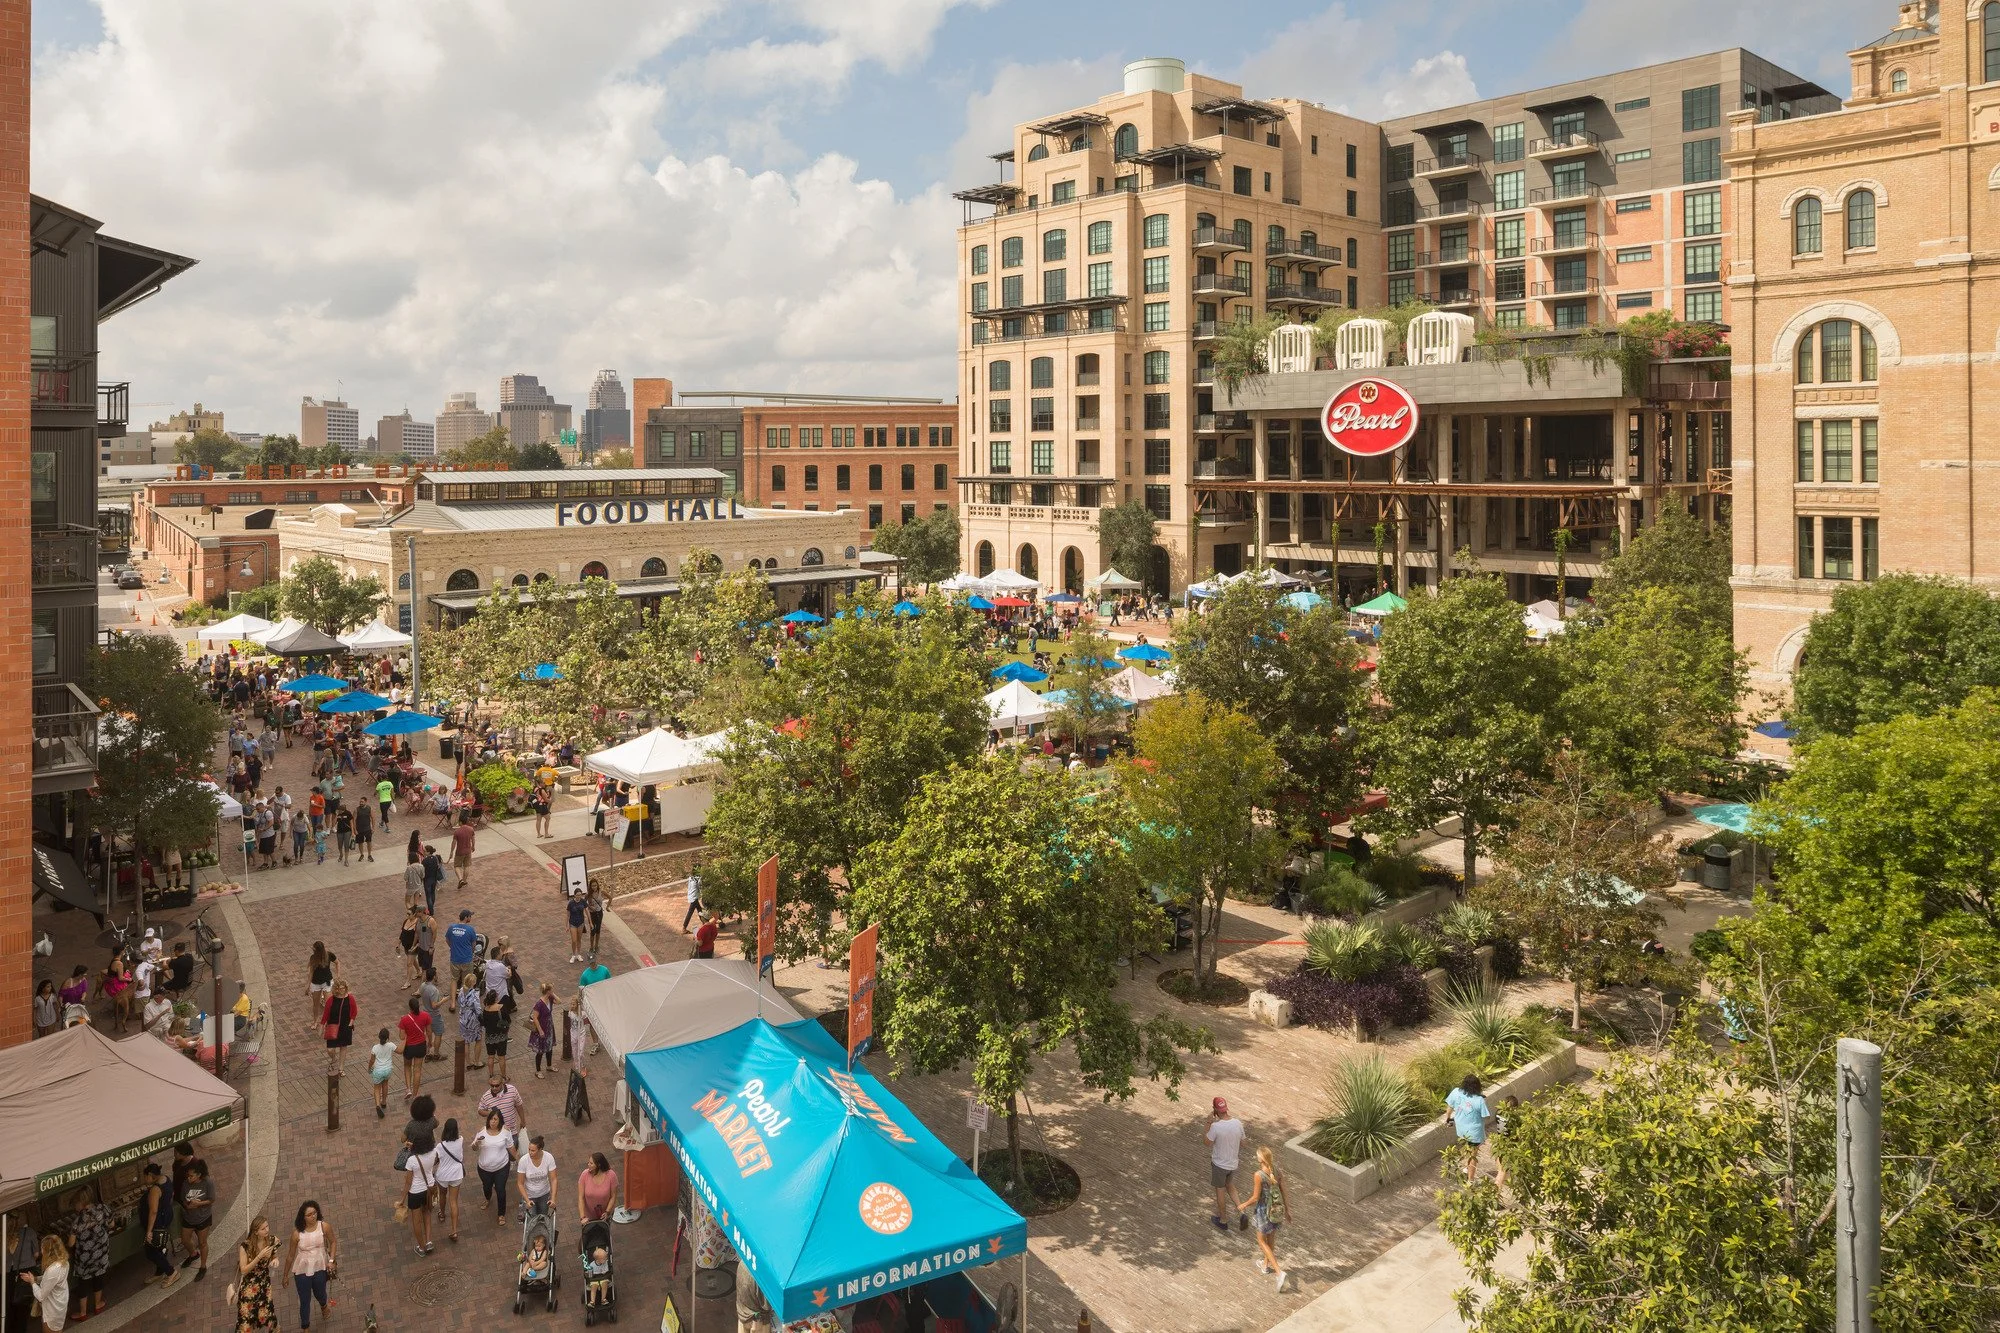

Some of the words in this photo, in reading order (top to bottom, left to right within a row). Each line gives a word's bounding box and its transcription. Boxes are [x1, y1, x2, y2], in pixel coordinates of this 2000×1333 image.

[1330, 402, 1409, 433] Pearl
[556, 501, 649, 527] FOOD
[665, 498, 744, 522] HALL
[691, 1089, 773, 1179] MARKET
[737, 1078, 792, 1138] Pearl
[39, 1173, 64, 1192] GOAT
[66, 1164, 90, 1183] MILK
[91, 1156, 114, 1174] SOAP
[120, 1146, 141, 1163] SKIN
[142, 1136, 168, 1155] SALVE
[173, 1129, 187, 1143] LIP
[188, 1118, 214, 1137] BALMS
[639, 1085, 660, 1122] MERCH
[670, 1131, 718, 1210] INFORMATION
[733, 1226, 757, 1271] MAPS
[863, 1185, 902, 1210] WEEKEND
[872, 1210, 909, 1230] MARKET
[837, 1244, 980, 1299] INFORMATION
